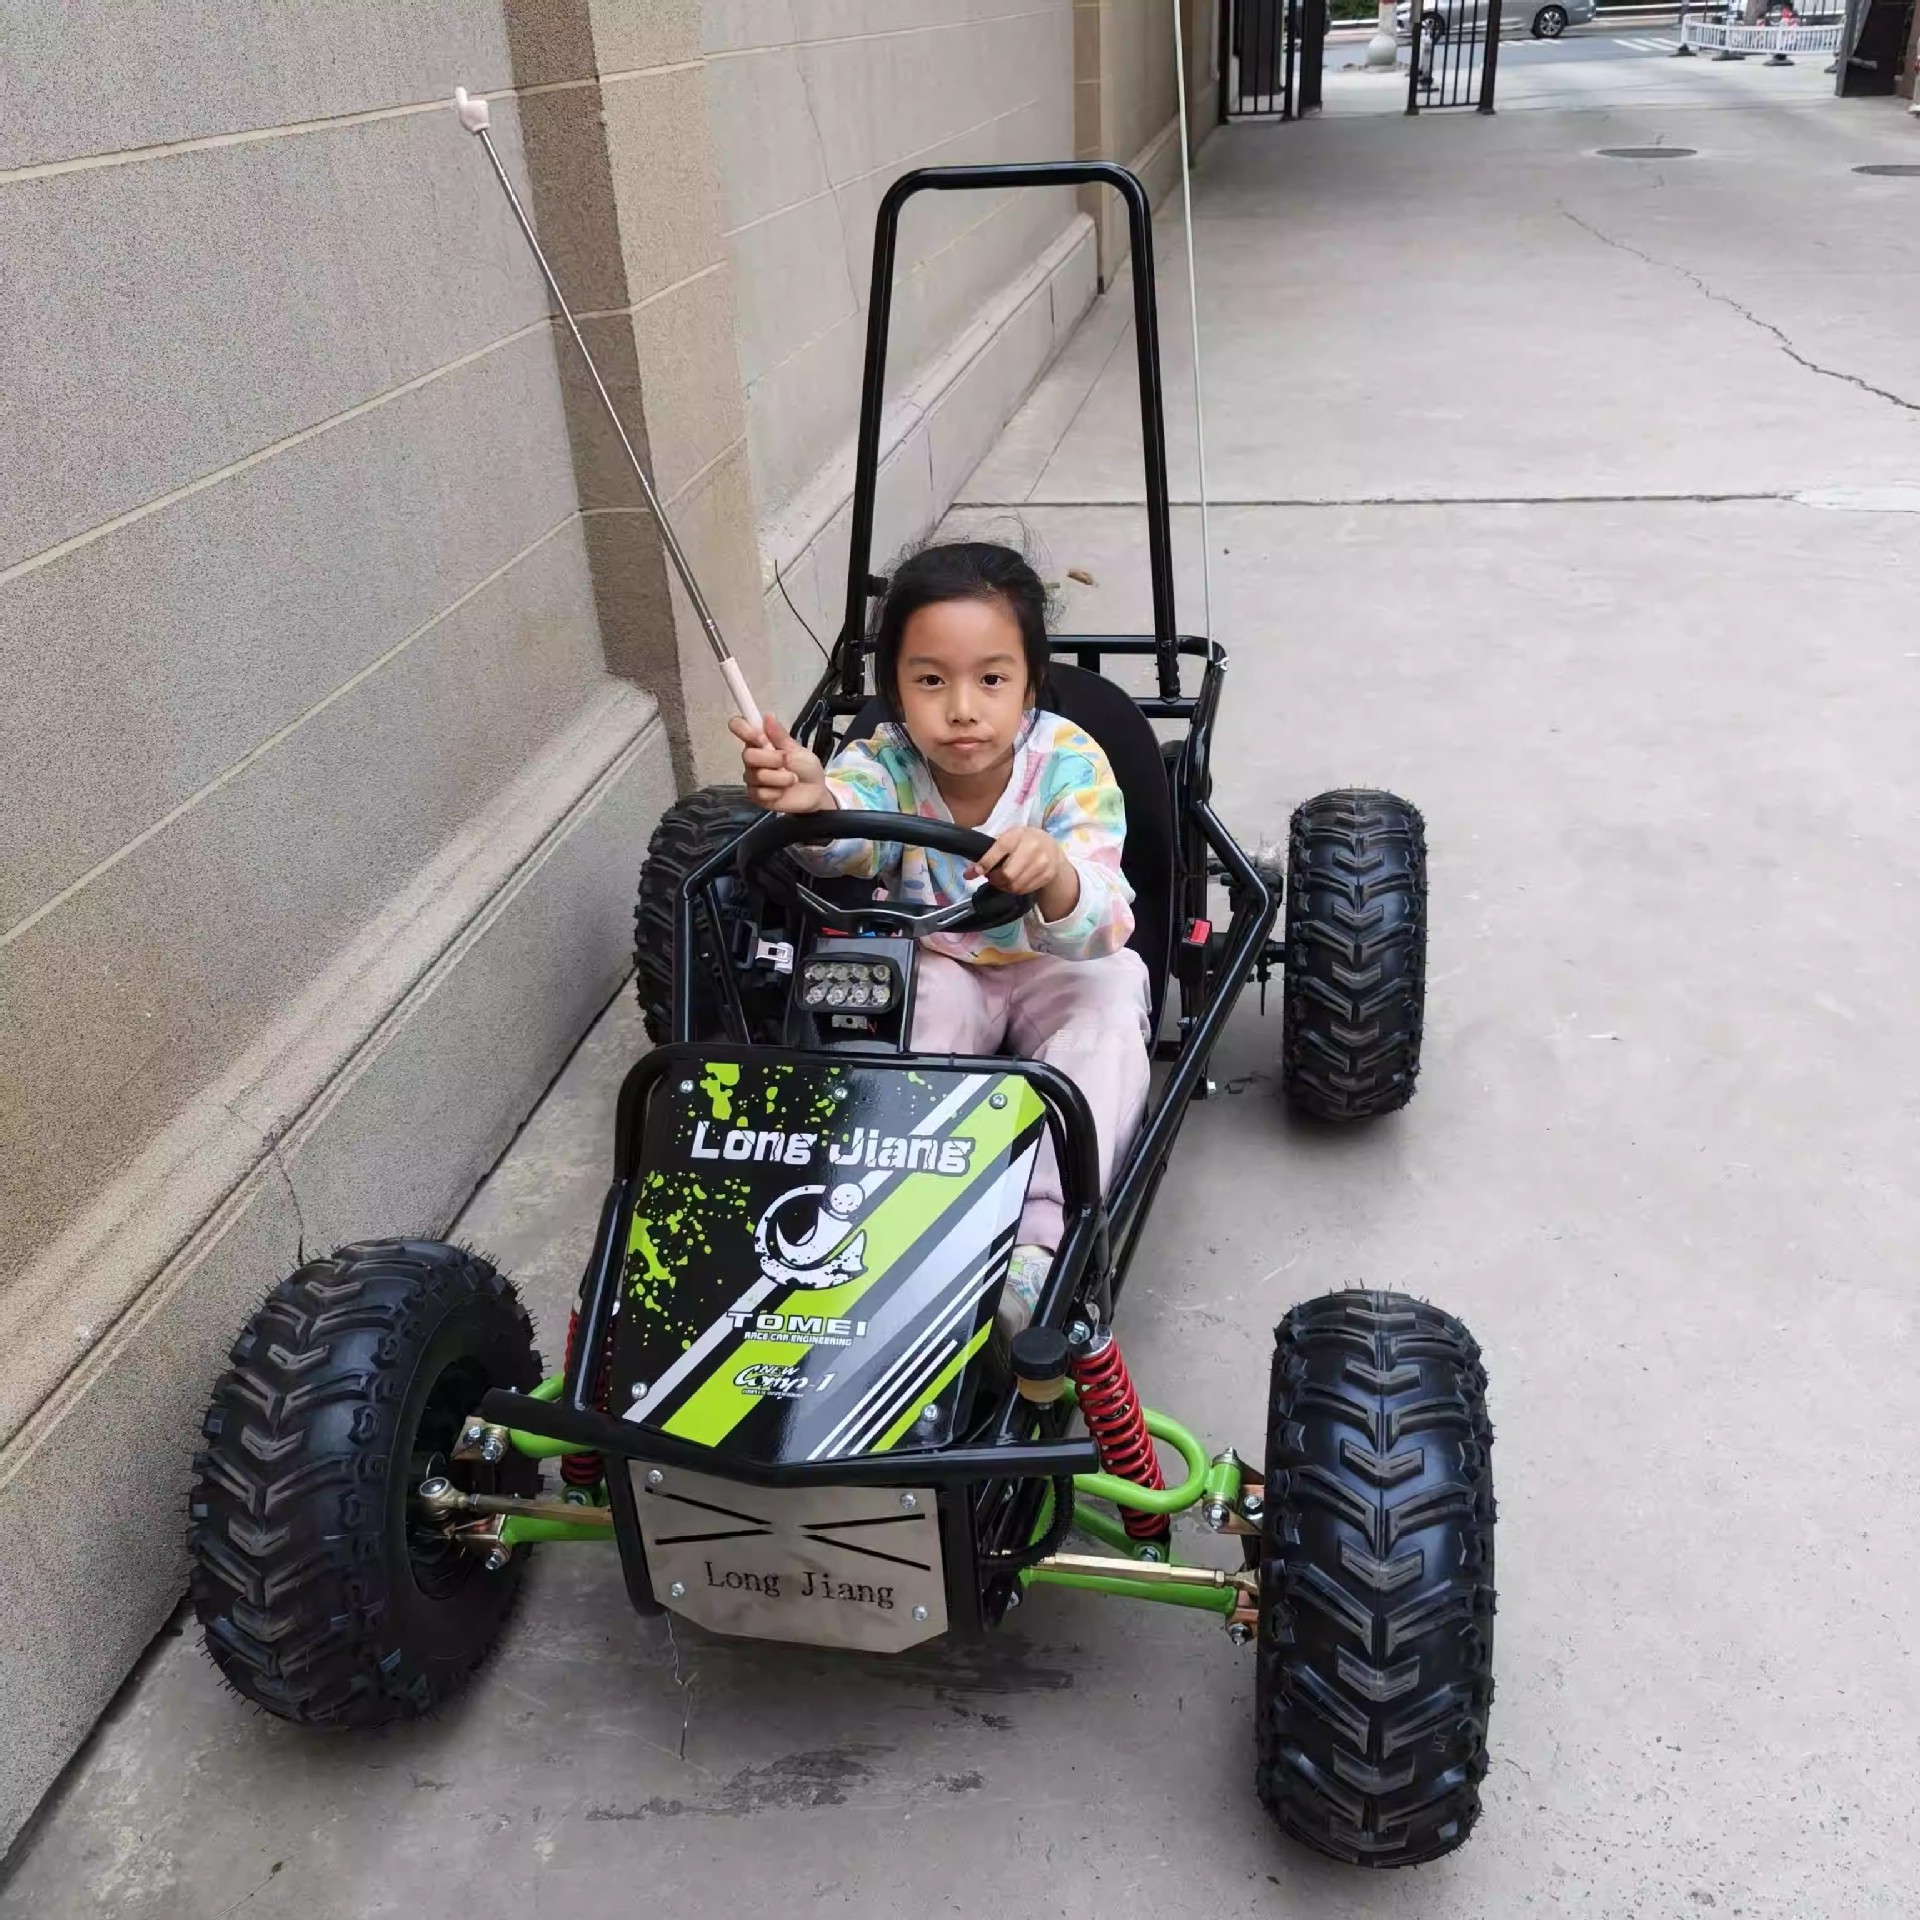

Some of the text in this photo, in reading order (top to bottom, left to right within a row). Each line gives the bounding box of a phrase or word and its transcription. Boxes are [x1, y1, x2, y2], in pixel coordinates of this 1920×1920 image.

[690, 1121, 972, 1175] Long Jiang
[728, 1312, 867, 1336] TOMEI
[744, 1331, 852, 1346] RACE CAR ENGINEERING
[704, 1561, 894, 1609] Long Jiang
